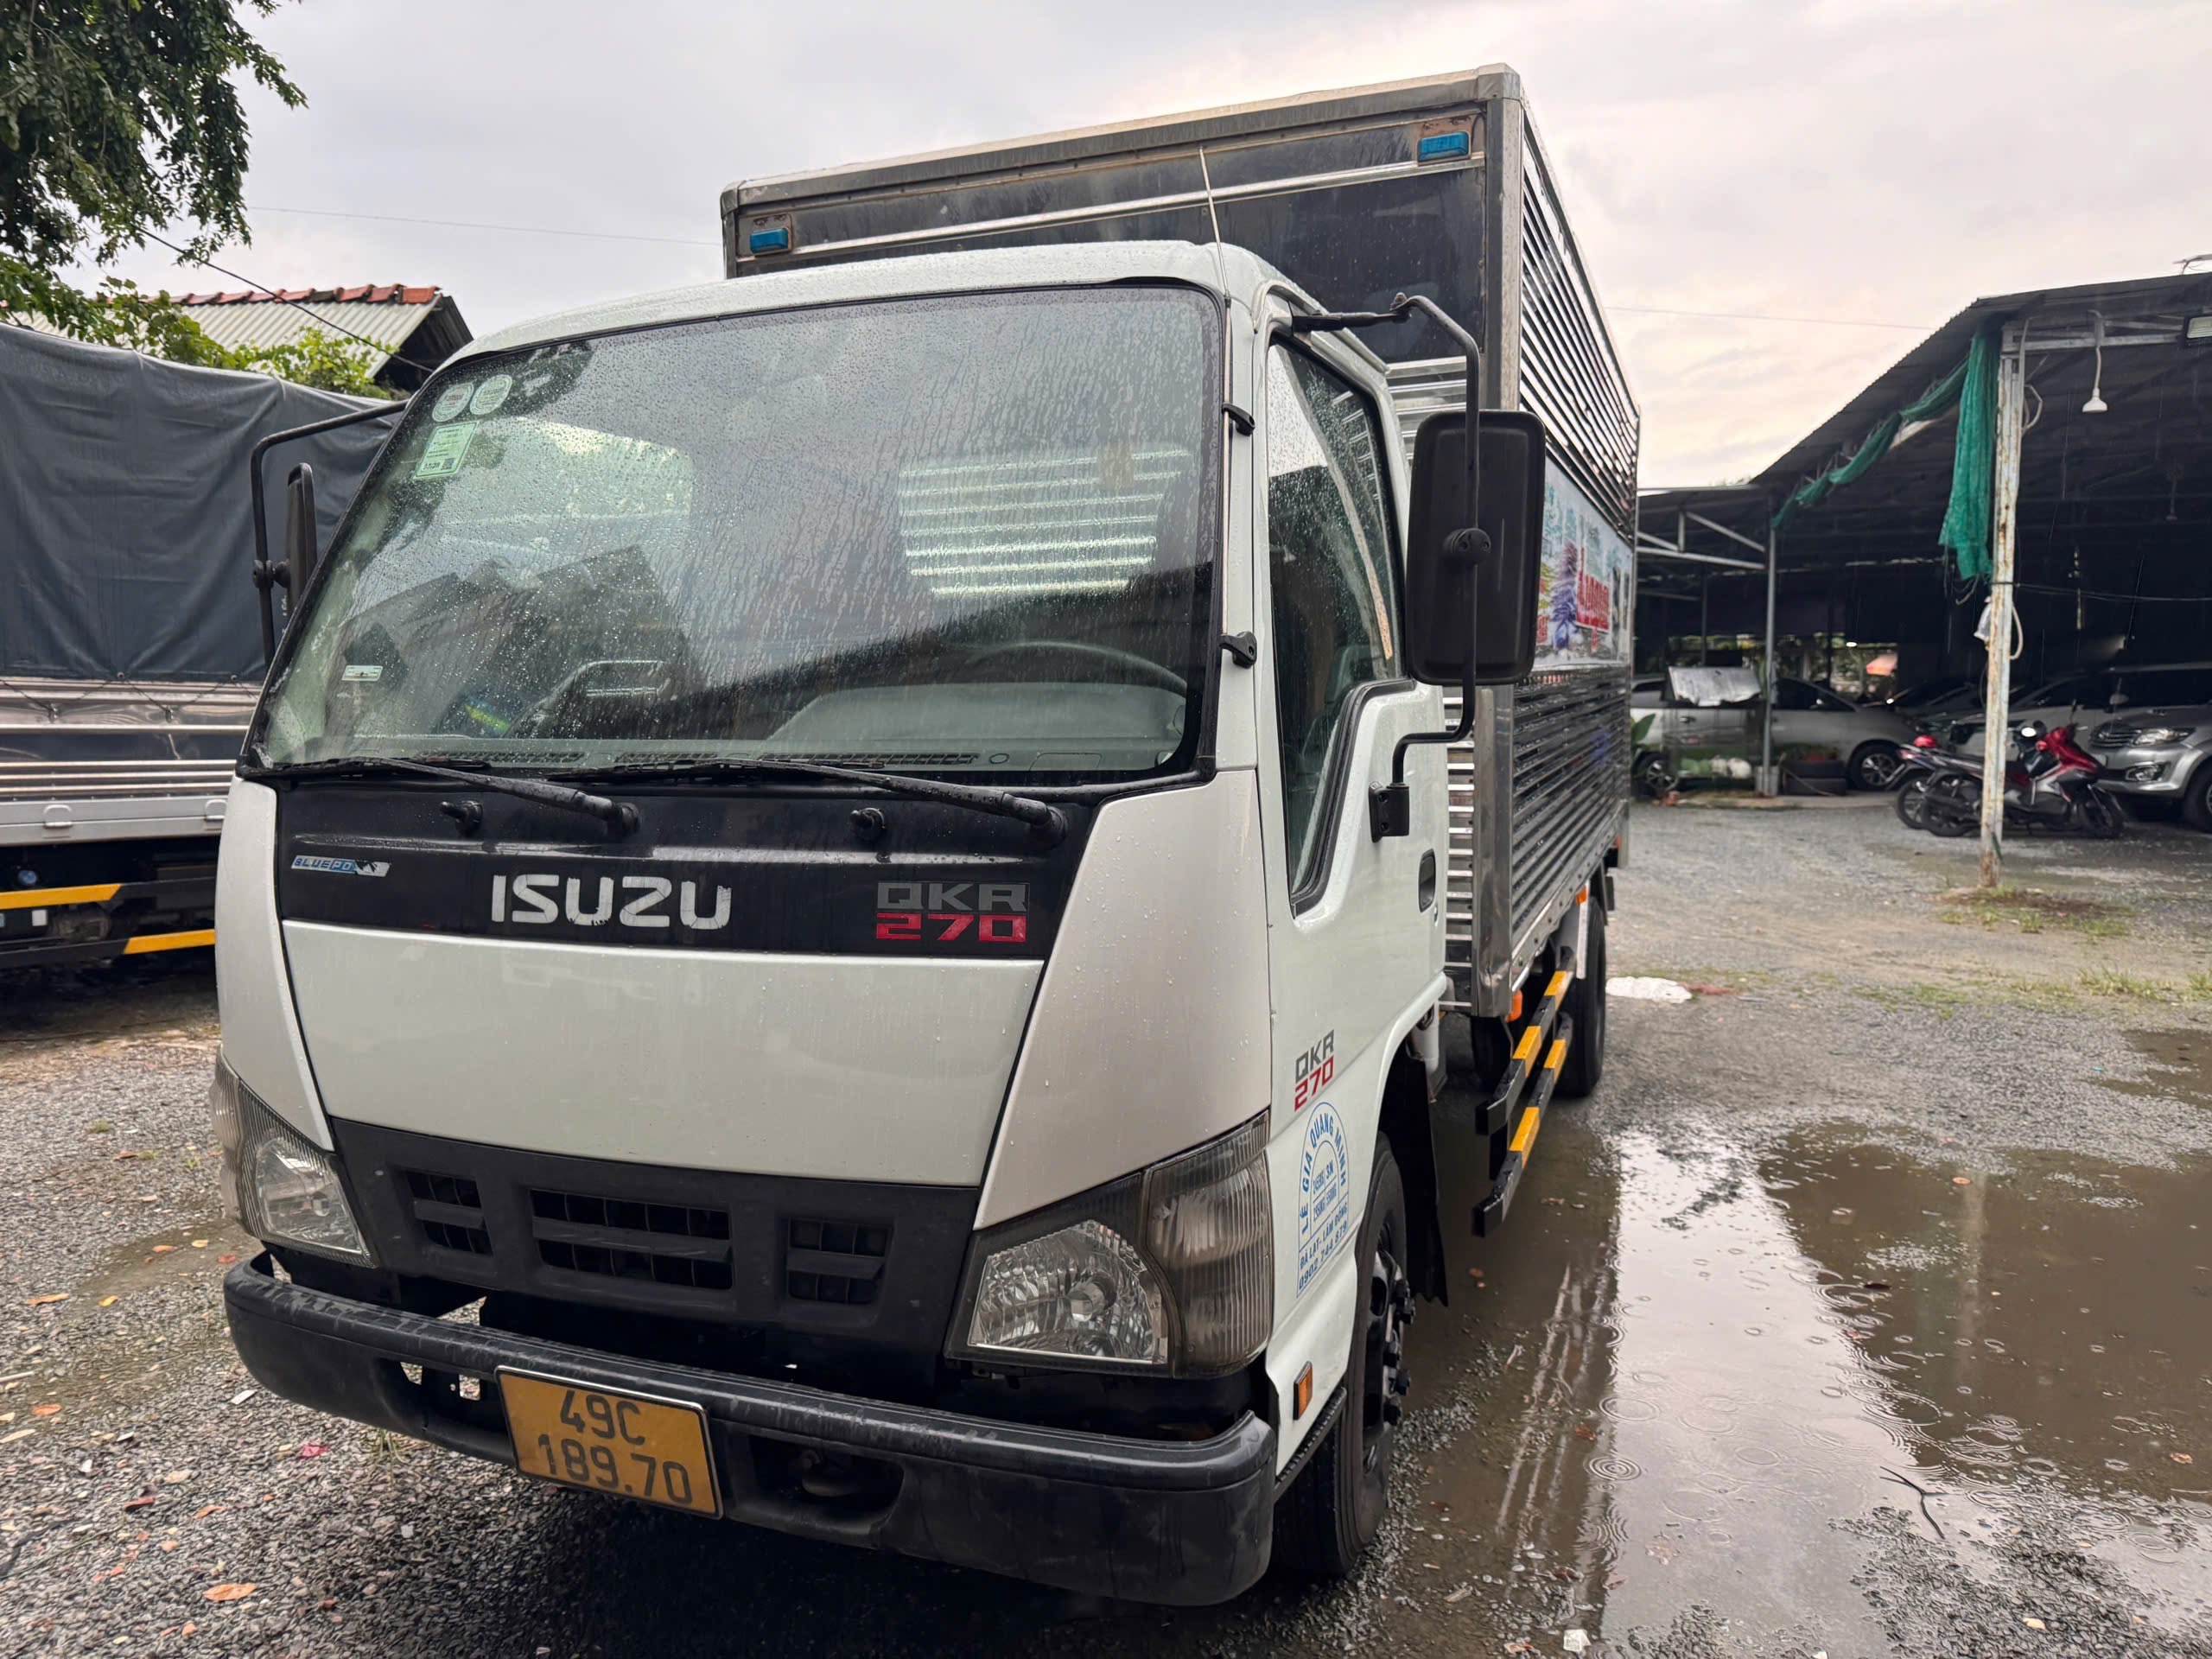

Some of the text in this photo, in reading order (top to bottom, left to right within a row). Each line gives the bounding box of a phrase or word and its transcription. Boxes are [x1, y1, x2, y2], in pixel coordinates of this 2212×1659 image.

[294, 857, 390, 876] BLUEPO
[492, 874, 732, 930] ISUZU
[877, 882, 1027, 912] QKR
[876, 912, 1027, 943] 270
[1294, 1055, 1334, 1112] 270
[1295, 1029, 1334, 1084] QKR
[1303, 1152, 1313, 1192] GIA
[1310, 1113, 1333, 1148] QUANG
[1335, 1127, 1346, 1186] MINH
[1326, 1160, 1334, 1179] 3N
[1299, 1220, 1347, 1290] 0902 744 879
[560, 1390, 646, 1446] 49C
[537, 1433, 692, 1504] 189.70
